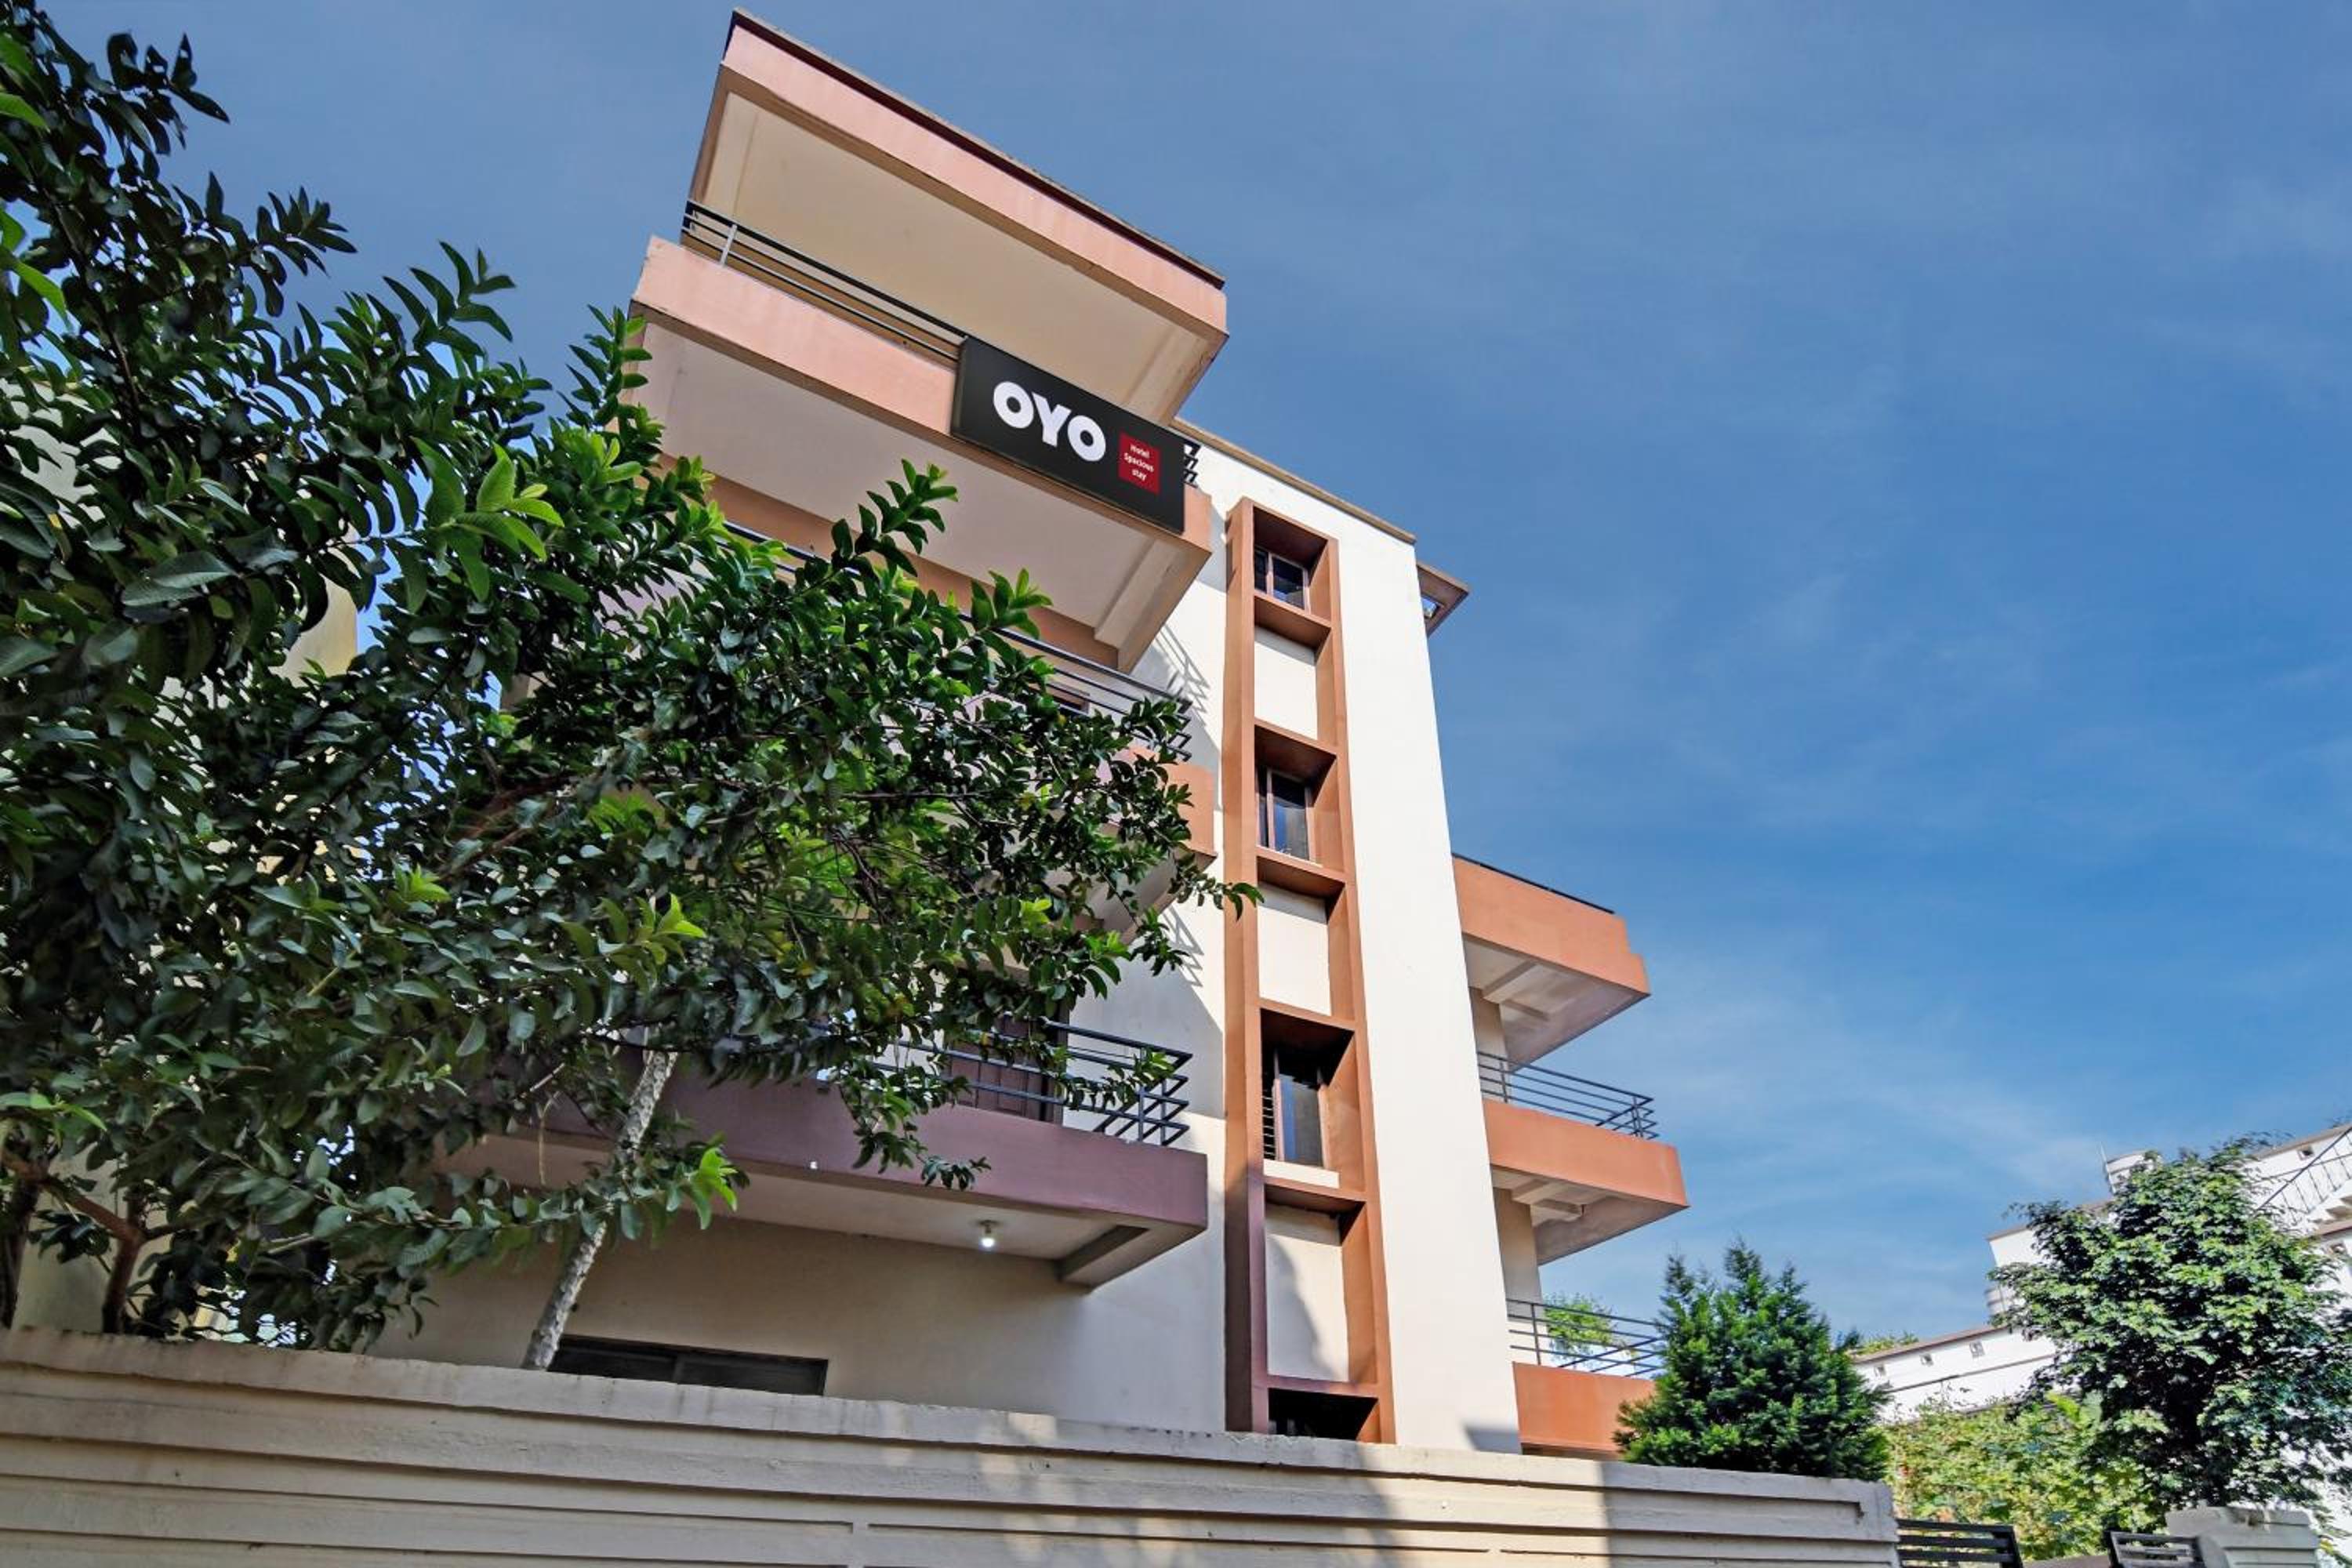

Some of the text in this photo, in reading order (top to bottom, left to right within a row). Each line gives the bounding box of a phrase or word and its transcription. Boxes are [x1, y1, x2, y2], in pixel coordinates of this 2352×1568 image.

[993, 381, 1106, 463] OYO
[1123, 452, 1154, 473] Spacious
[1131, 445, 1150, 459] Hotel
